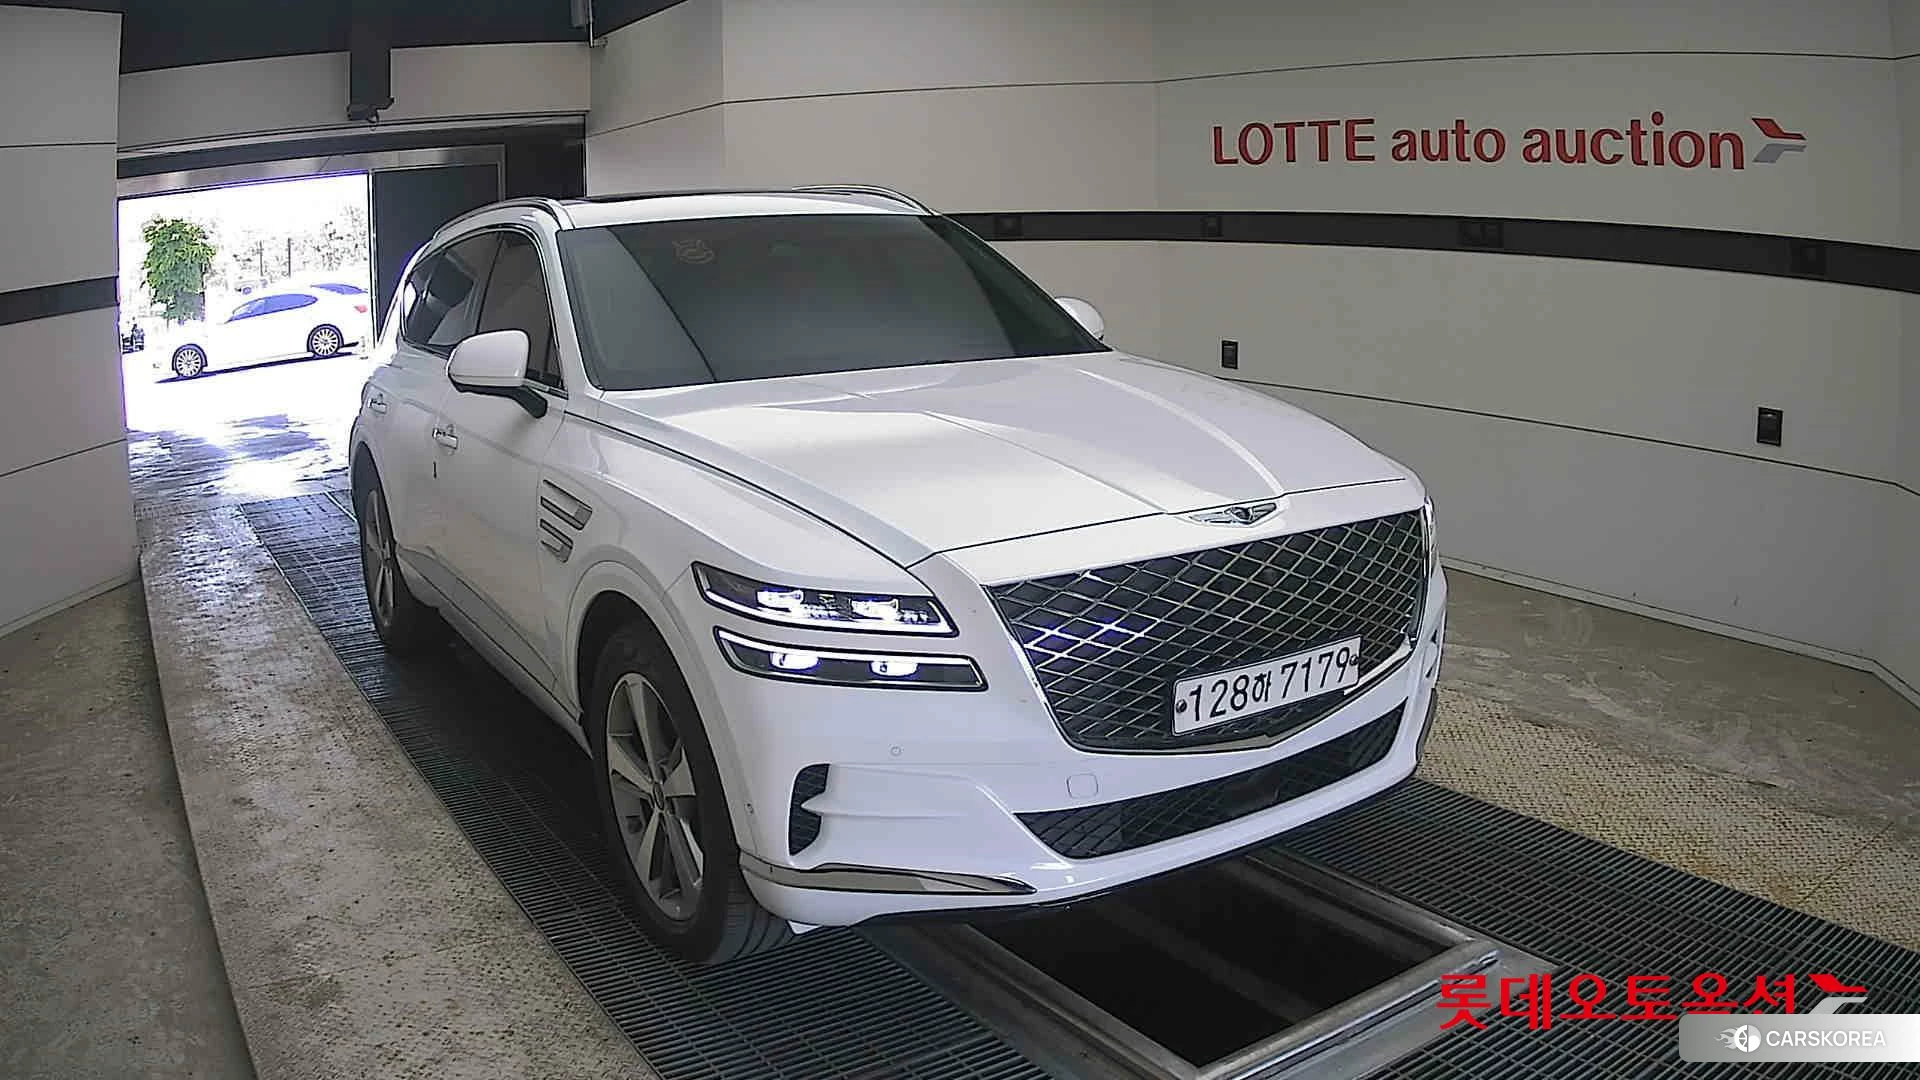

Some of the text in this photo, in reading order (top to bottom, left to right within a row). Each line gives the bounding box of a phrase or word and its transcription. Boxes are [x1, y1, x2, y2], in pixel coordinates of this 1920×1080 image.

[1213, 111, 1745, 170] LOTTE auto auction
[1189, 646, 1350, 721] 128하 7179
